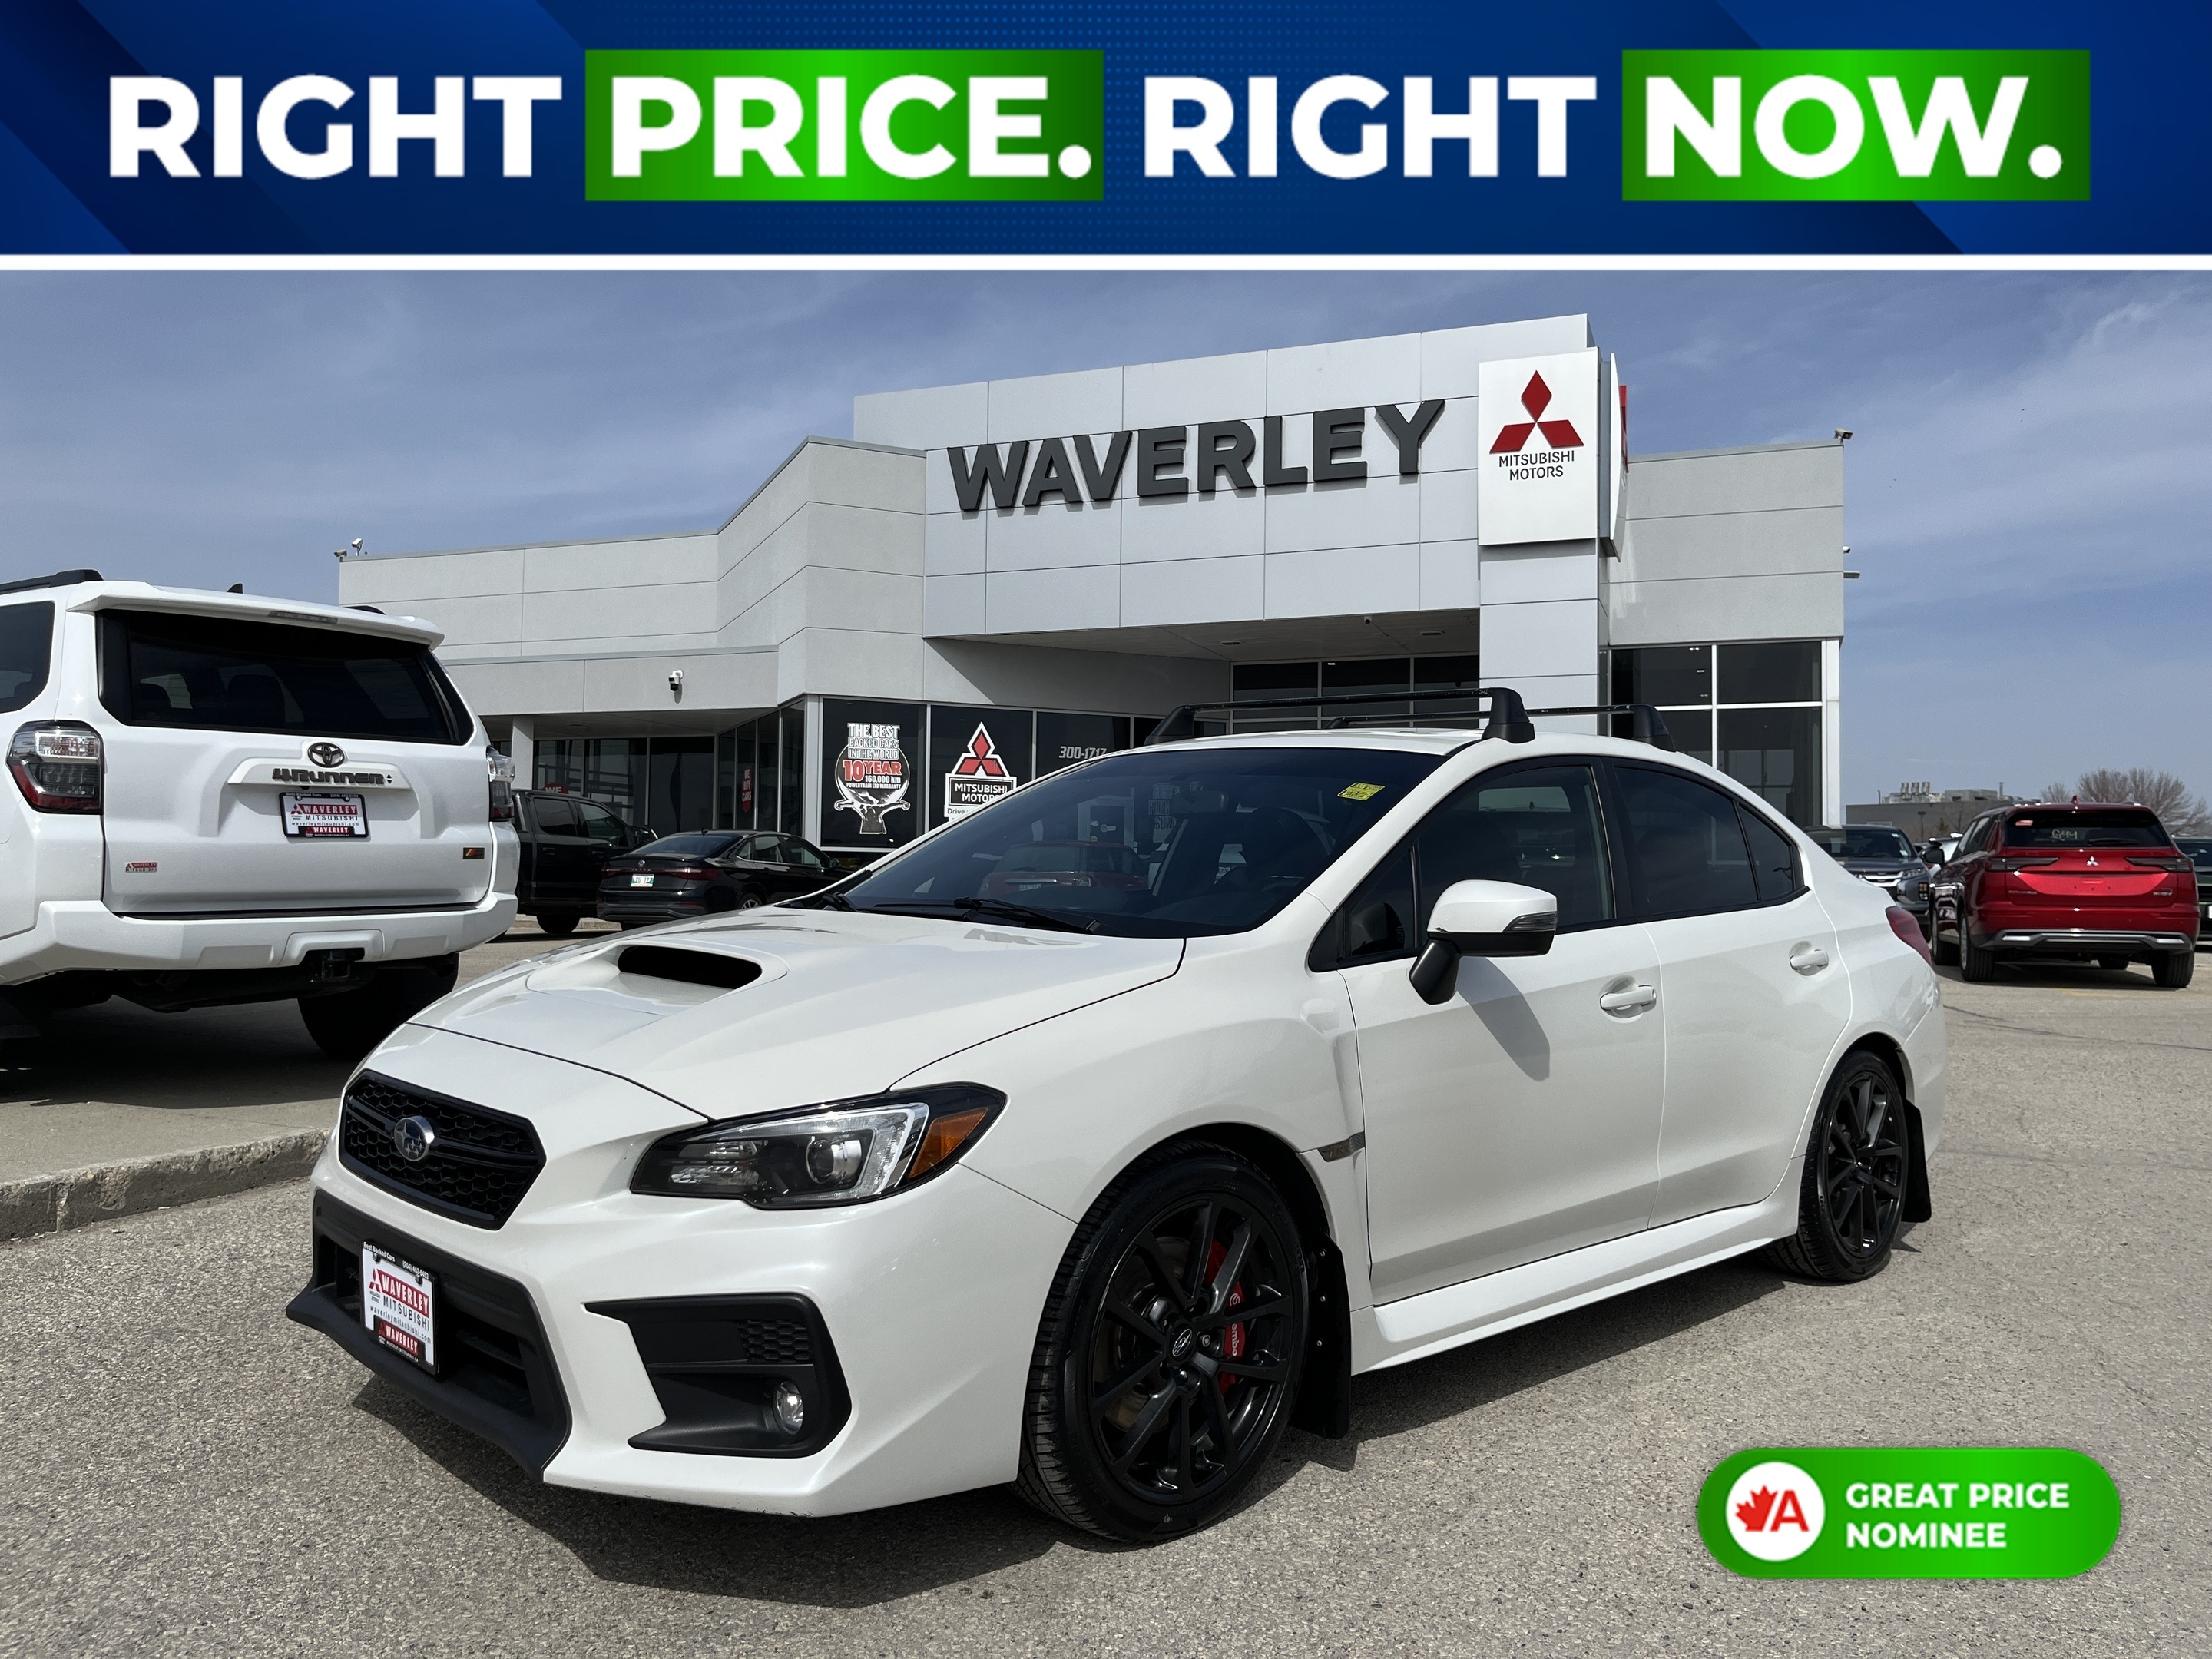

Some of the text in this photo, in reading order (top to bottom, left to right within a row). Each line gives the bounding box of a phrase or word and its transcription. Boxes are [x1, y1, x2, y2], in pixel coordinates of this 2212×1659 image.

[948, 399, 1445, 512] WAVERLEY
[1498, 450, 1575, 468] MITSUBISHI
[1509, 465, 1564, 481] MOTORS
[848, 724, 899, 739] THE BEST
[849, 738, 899, 749] BACKED CARS
[849, 748, 899, 760] IN THE WORLD
[1058, 746, 1108, 760] 300-1717
[843, 760, 902, 782] 10 YEAR
[865, 775, 889, 783] 160,000
[955, 783, 1008, 793] MITSUBISHI
[962, 793, 1000, 803] MOTOR
[303, 804, 356, 814] WAVERLEY
[382, 1273, 429, 1314] WAVERLEY
[383, 1295, 430, 1332] MITSUBISHI
[369, 1305, 432, 1344] waverleymitsubishi.com
[386, 1324, 418, 1353] WAVERLEY
[1231, 1323, 1240, 1356] embo
